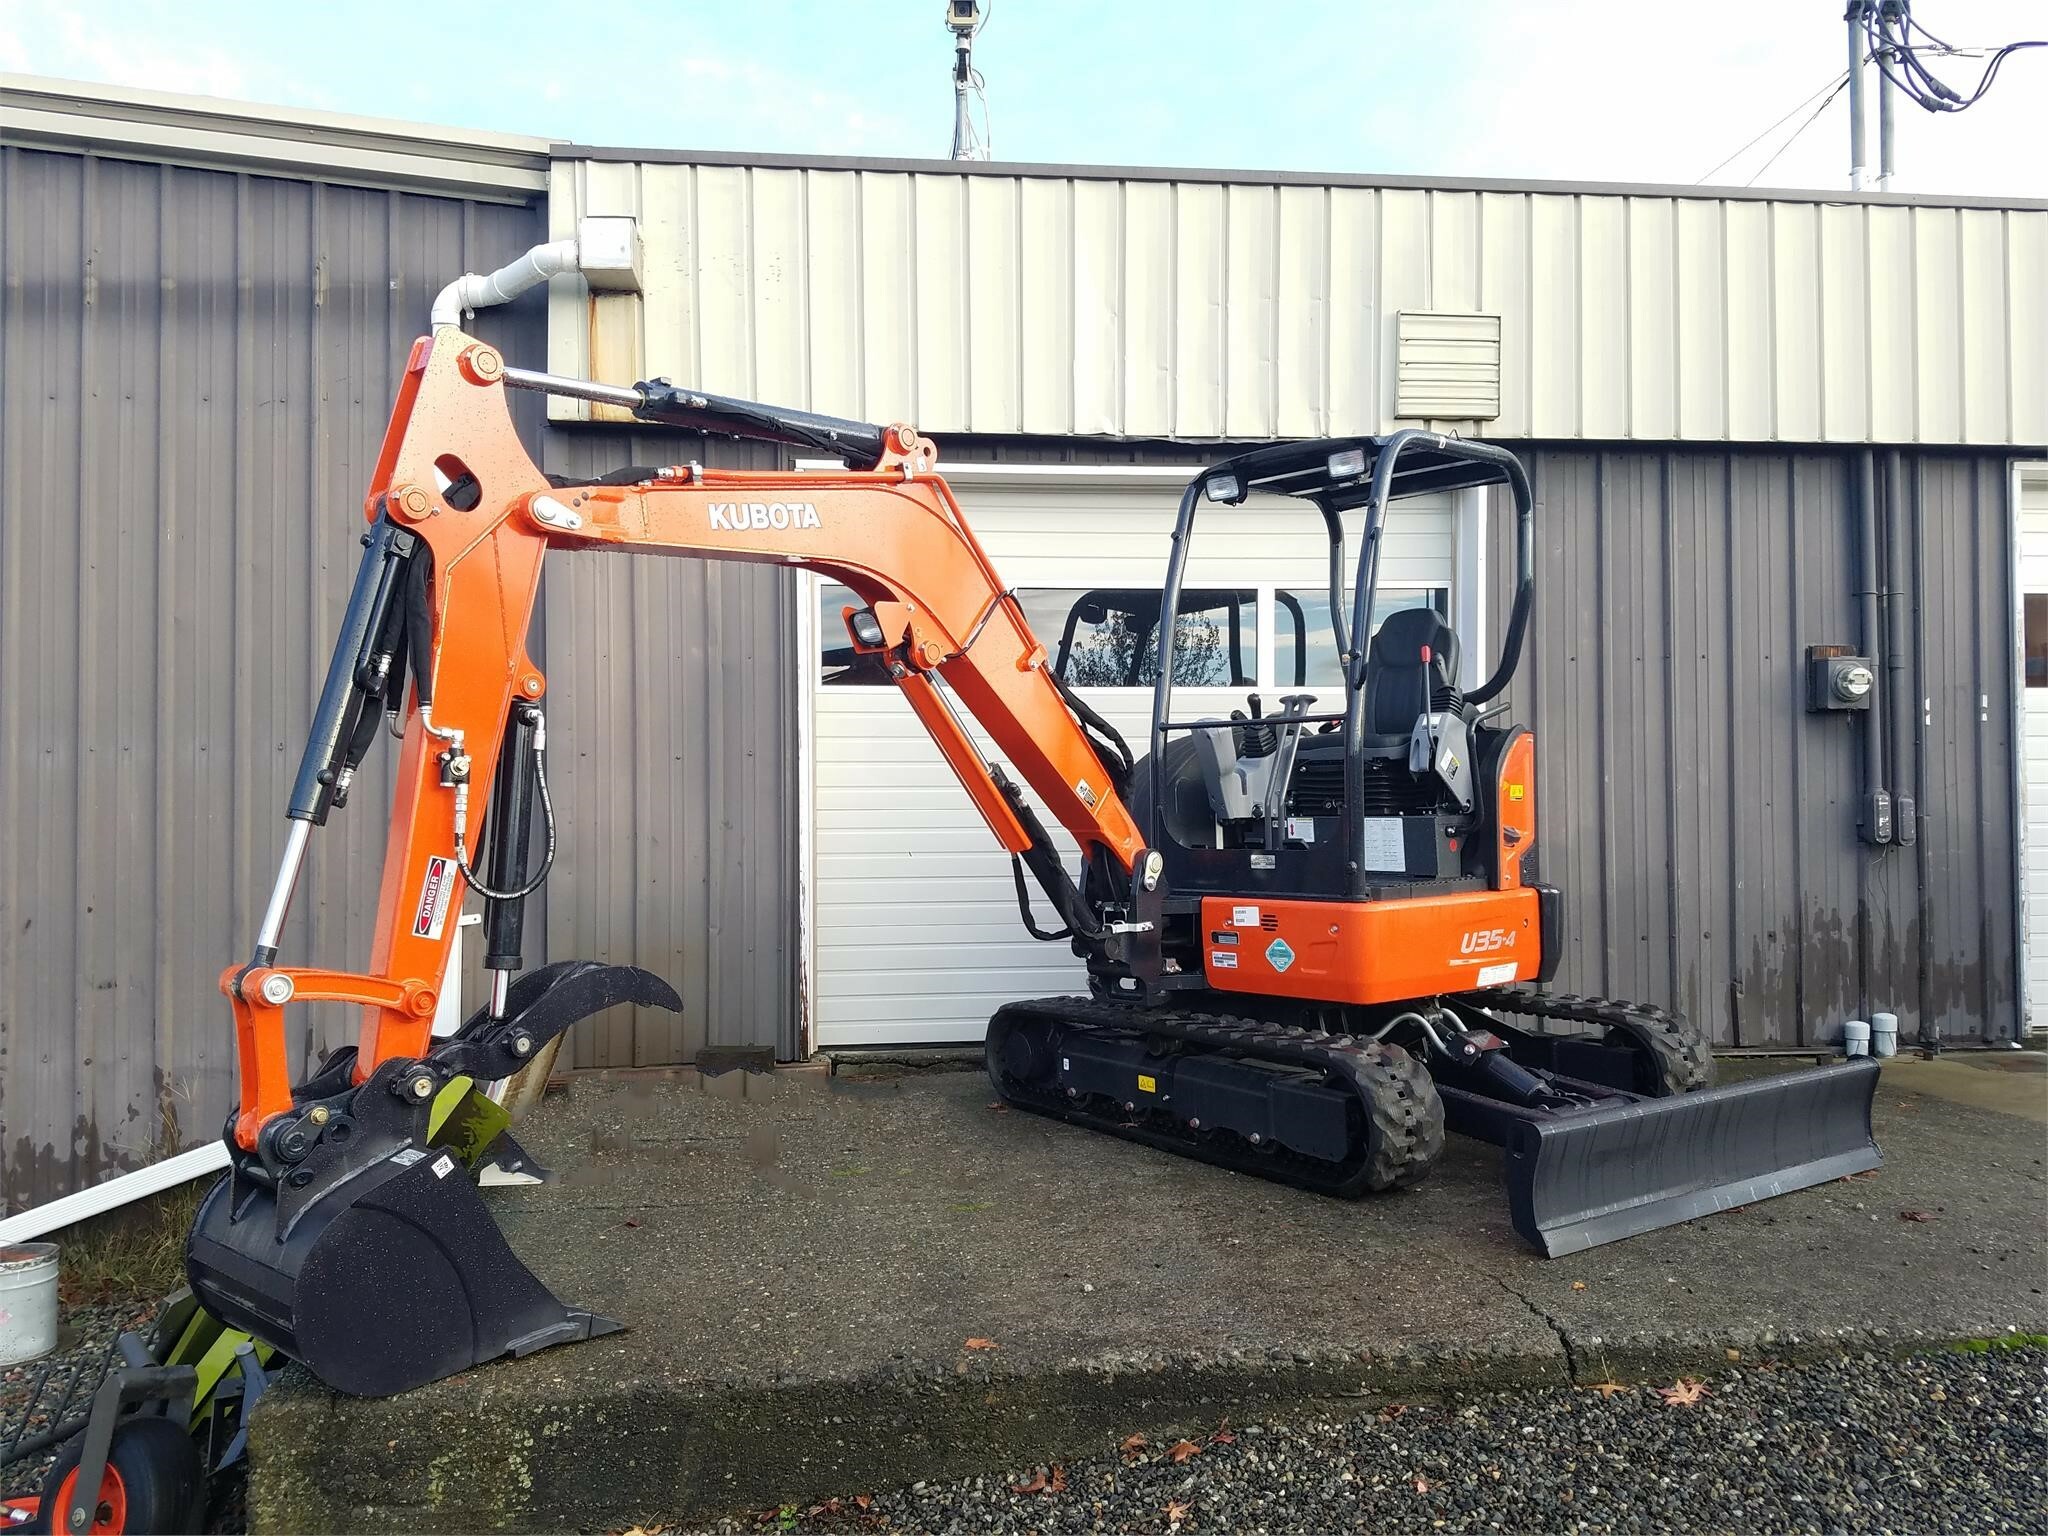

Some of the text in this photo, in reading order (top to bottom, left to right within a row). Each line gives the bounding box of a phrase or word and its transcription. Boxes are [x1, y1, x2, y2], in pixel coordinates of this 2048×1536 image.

[708, 503, 822, 530] KUBOTA
[423, 876, 439, 917] DANGER
[1461, 929, 1516, 954] U35-4
